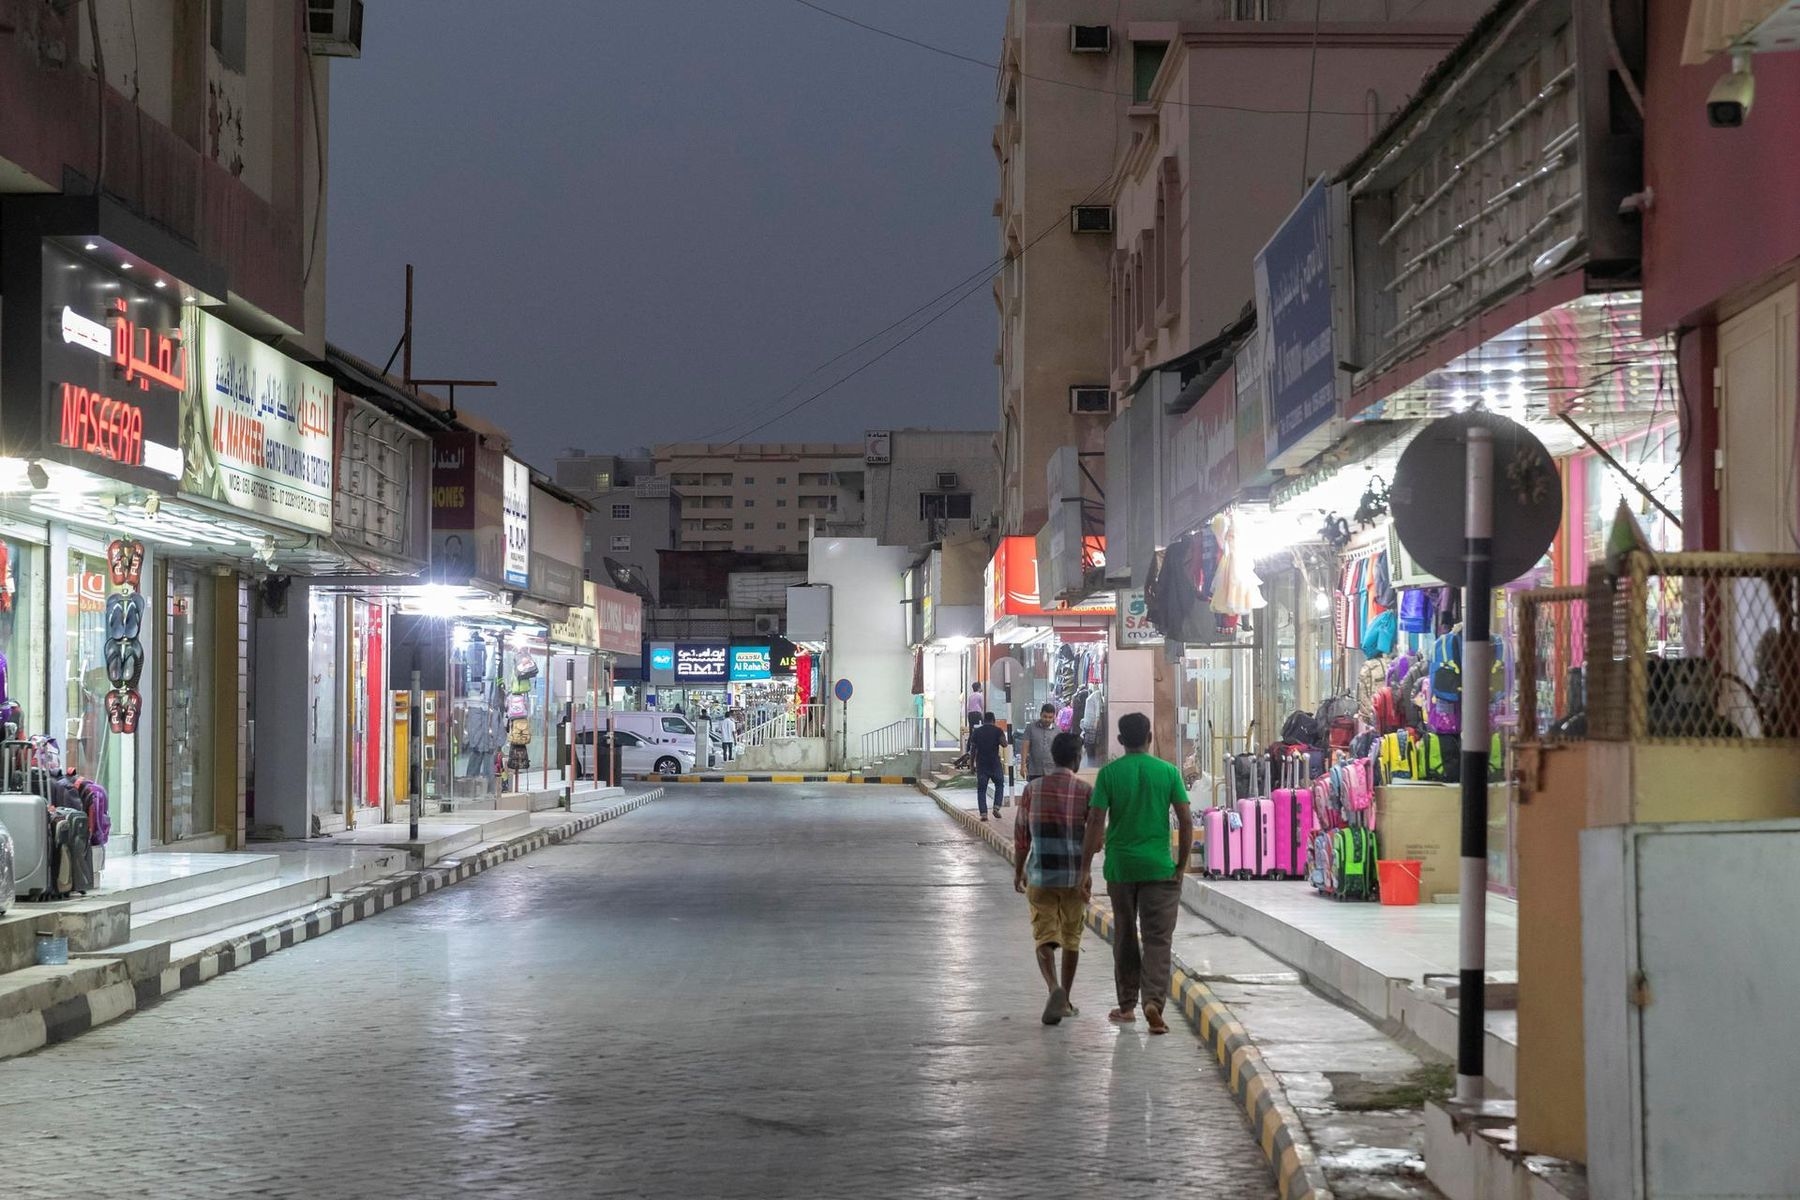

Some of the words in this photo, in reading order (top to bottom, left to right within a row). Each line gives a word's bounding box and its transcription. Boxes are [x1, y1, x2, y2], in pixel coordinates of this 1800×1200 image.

[116, 297, 187, 392] نصيرة
[60, 382, 143, 467] NASEERA
[212, 405, 223, 453] AL
[227, 410, 265, 469] NAKHEEL
